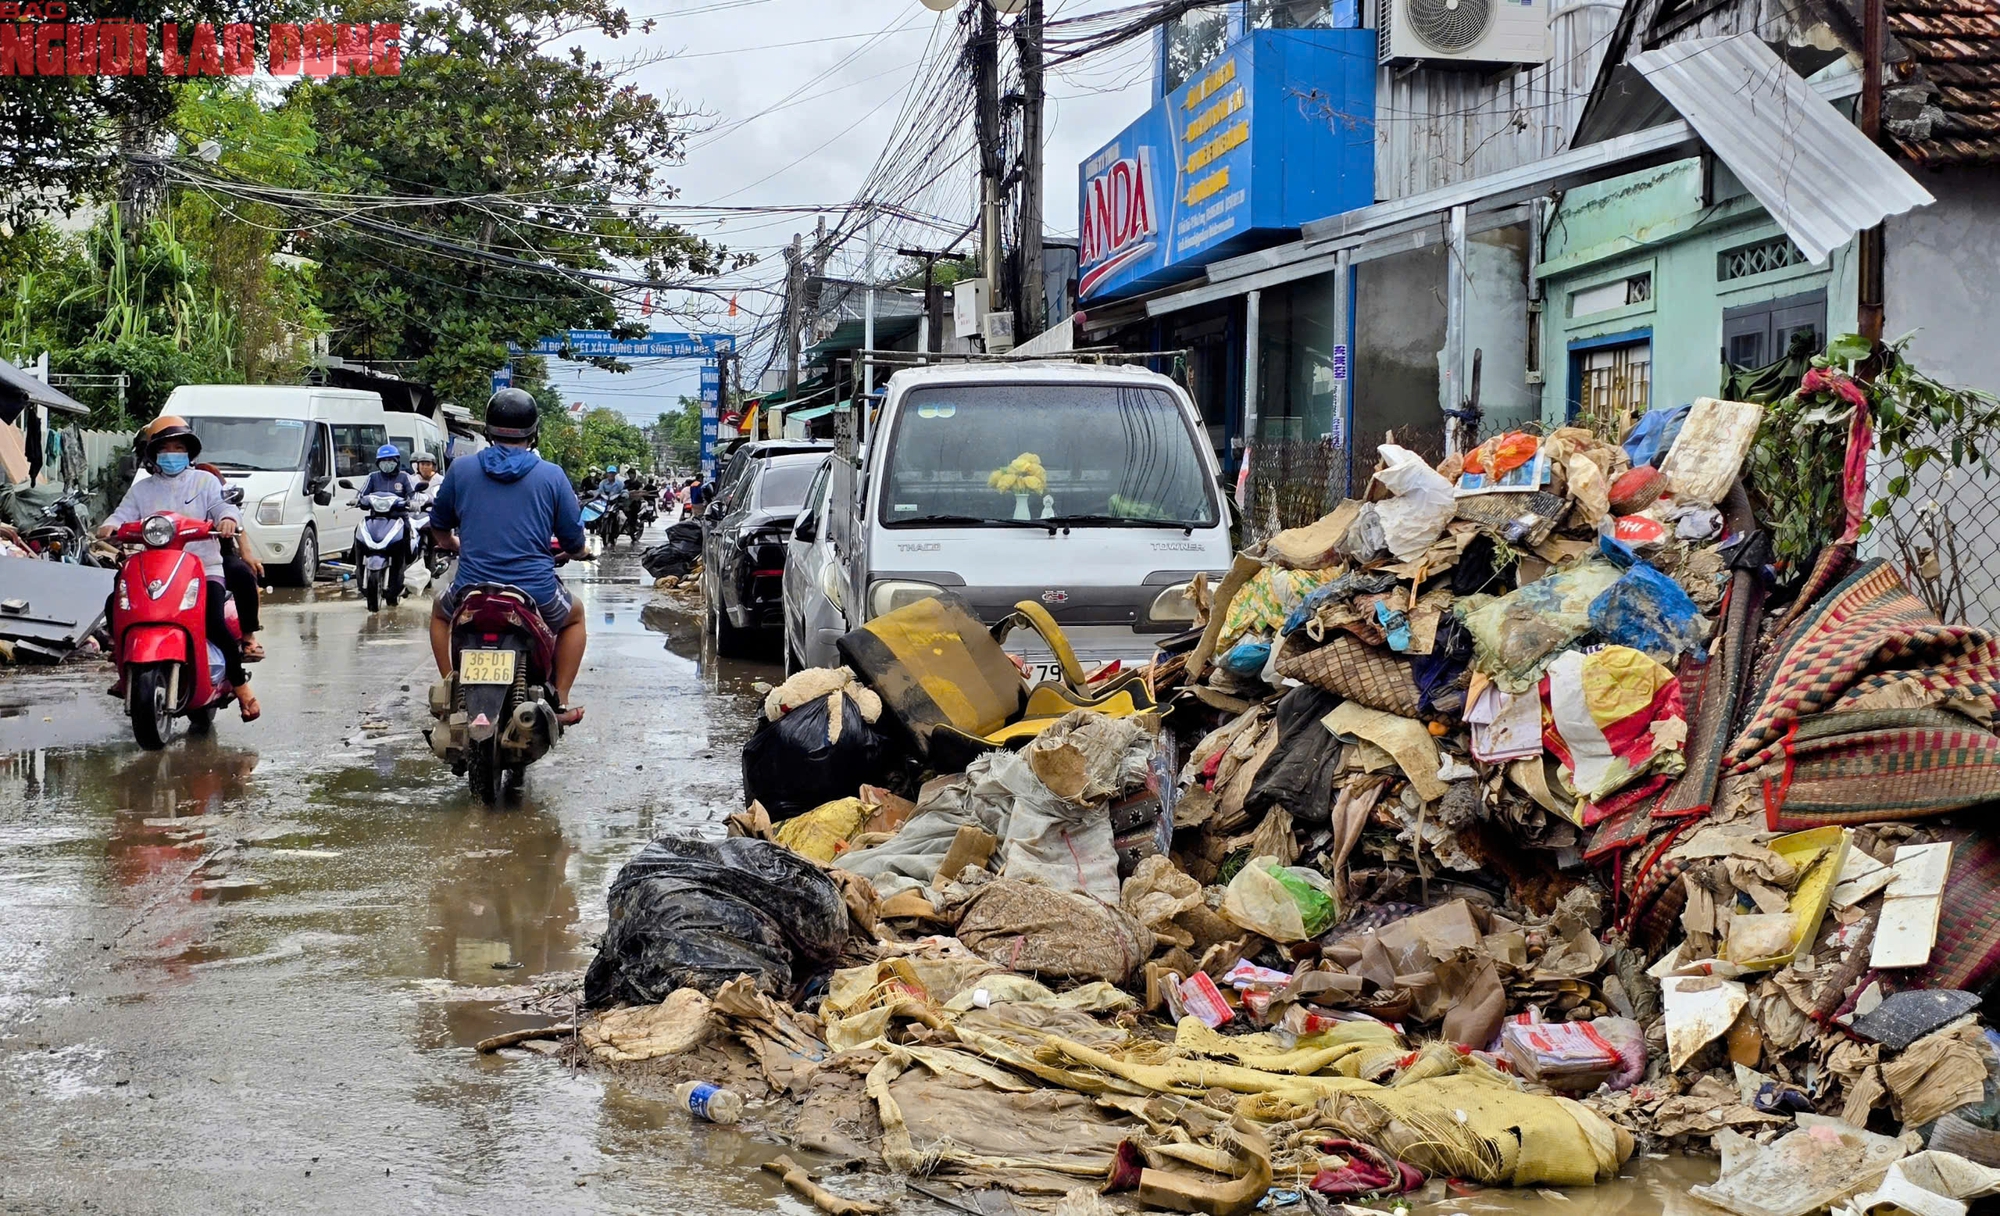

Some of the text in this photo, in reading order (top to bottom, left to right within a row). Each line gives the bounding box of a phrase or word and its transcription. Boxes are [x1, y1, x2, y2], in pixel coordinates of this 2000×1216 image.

[1079, 147, 1156, 267] ANDA
[591, 341, 608, 353] XÂY
[897, 543, 941, 552] THACO
[1150, 542, 1206, 552] TOWNER
[464, 667, 510, 681] 432.66
